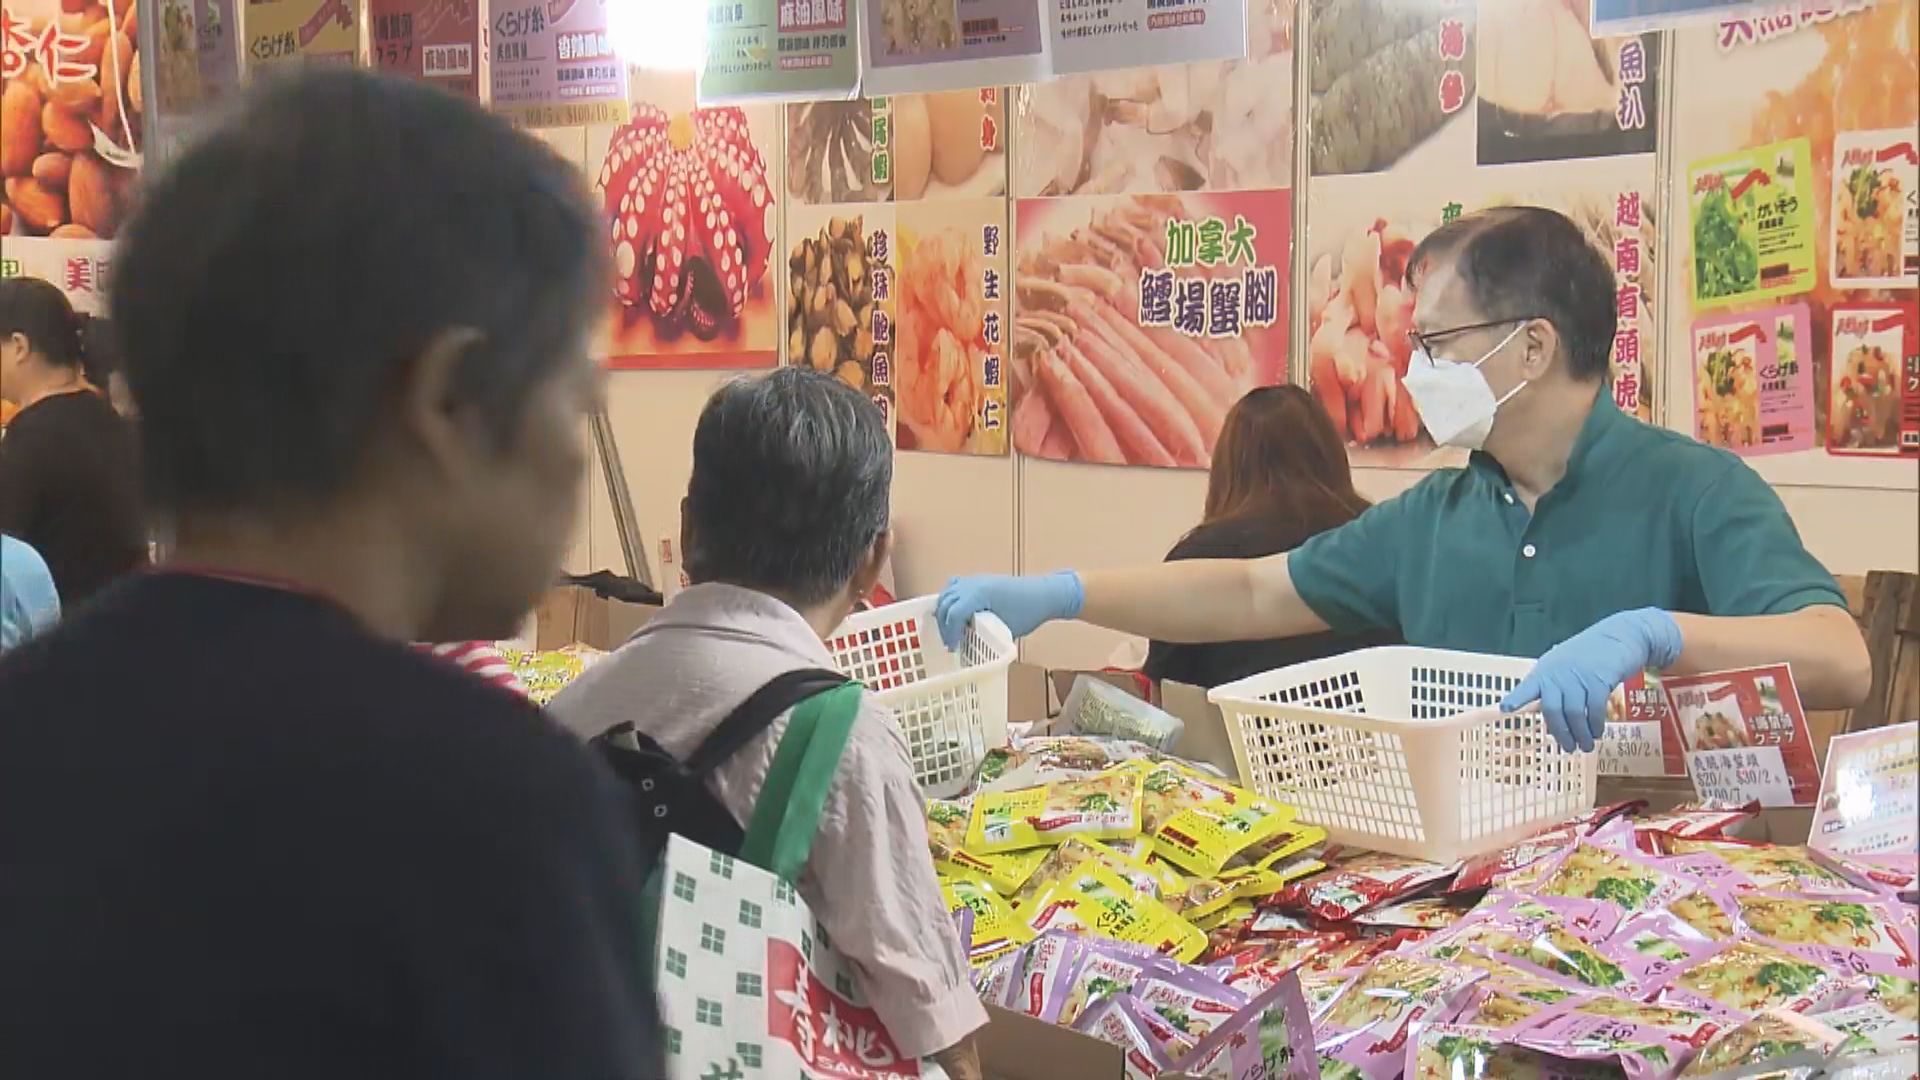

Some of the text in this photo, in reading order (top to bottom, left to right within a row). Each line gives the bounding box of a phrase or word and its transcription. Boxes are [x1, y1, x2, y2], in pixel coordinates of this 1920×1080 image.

[1166, 216, 1256, 266] 加拿大
[983, 225, 999, 430] 野生花蝦仁
[1140, 270, 1276, 335] 鱈場蟹腳
